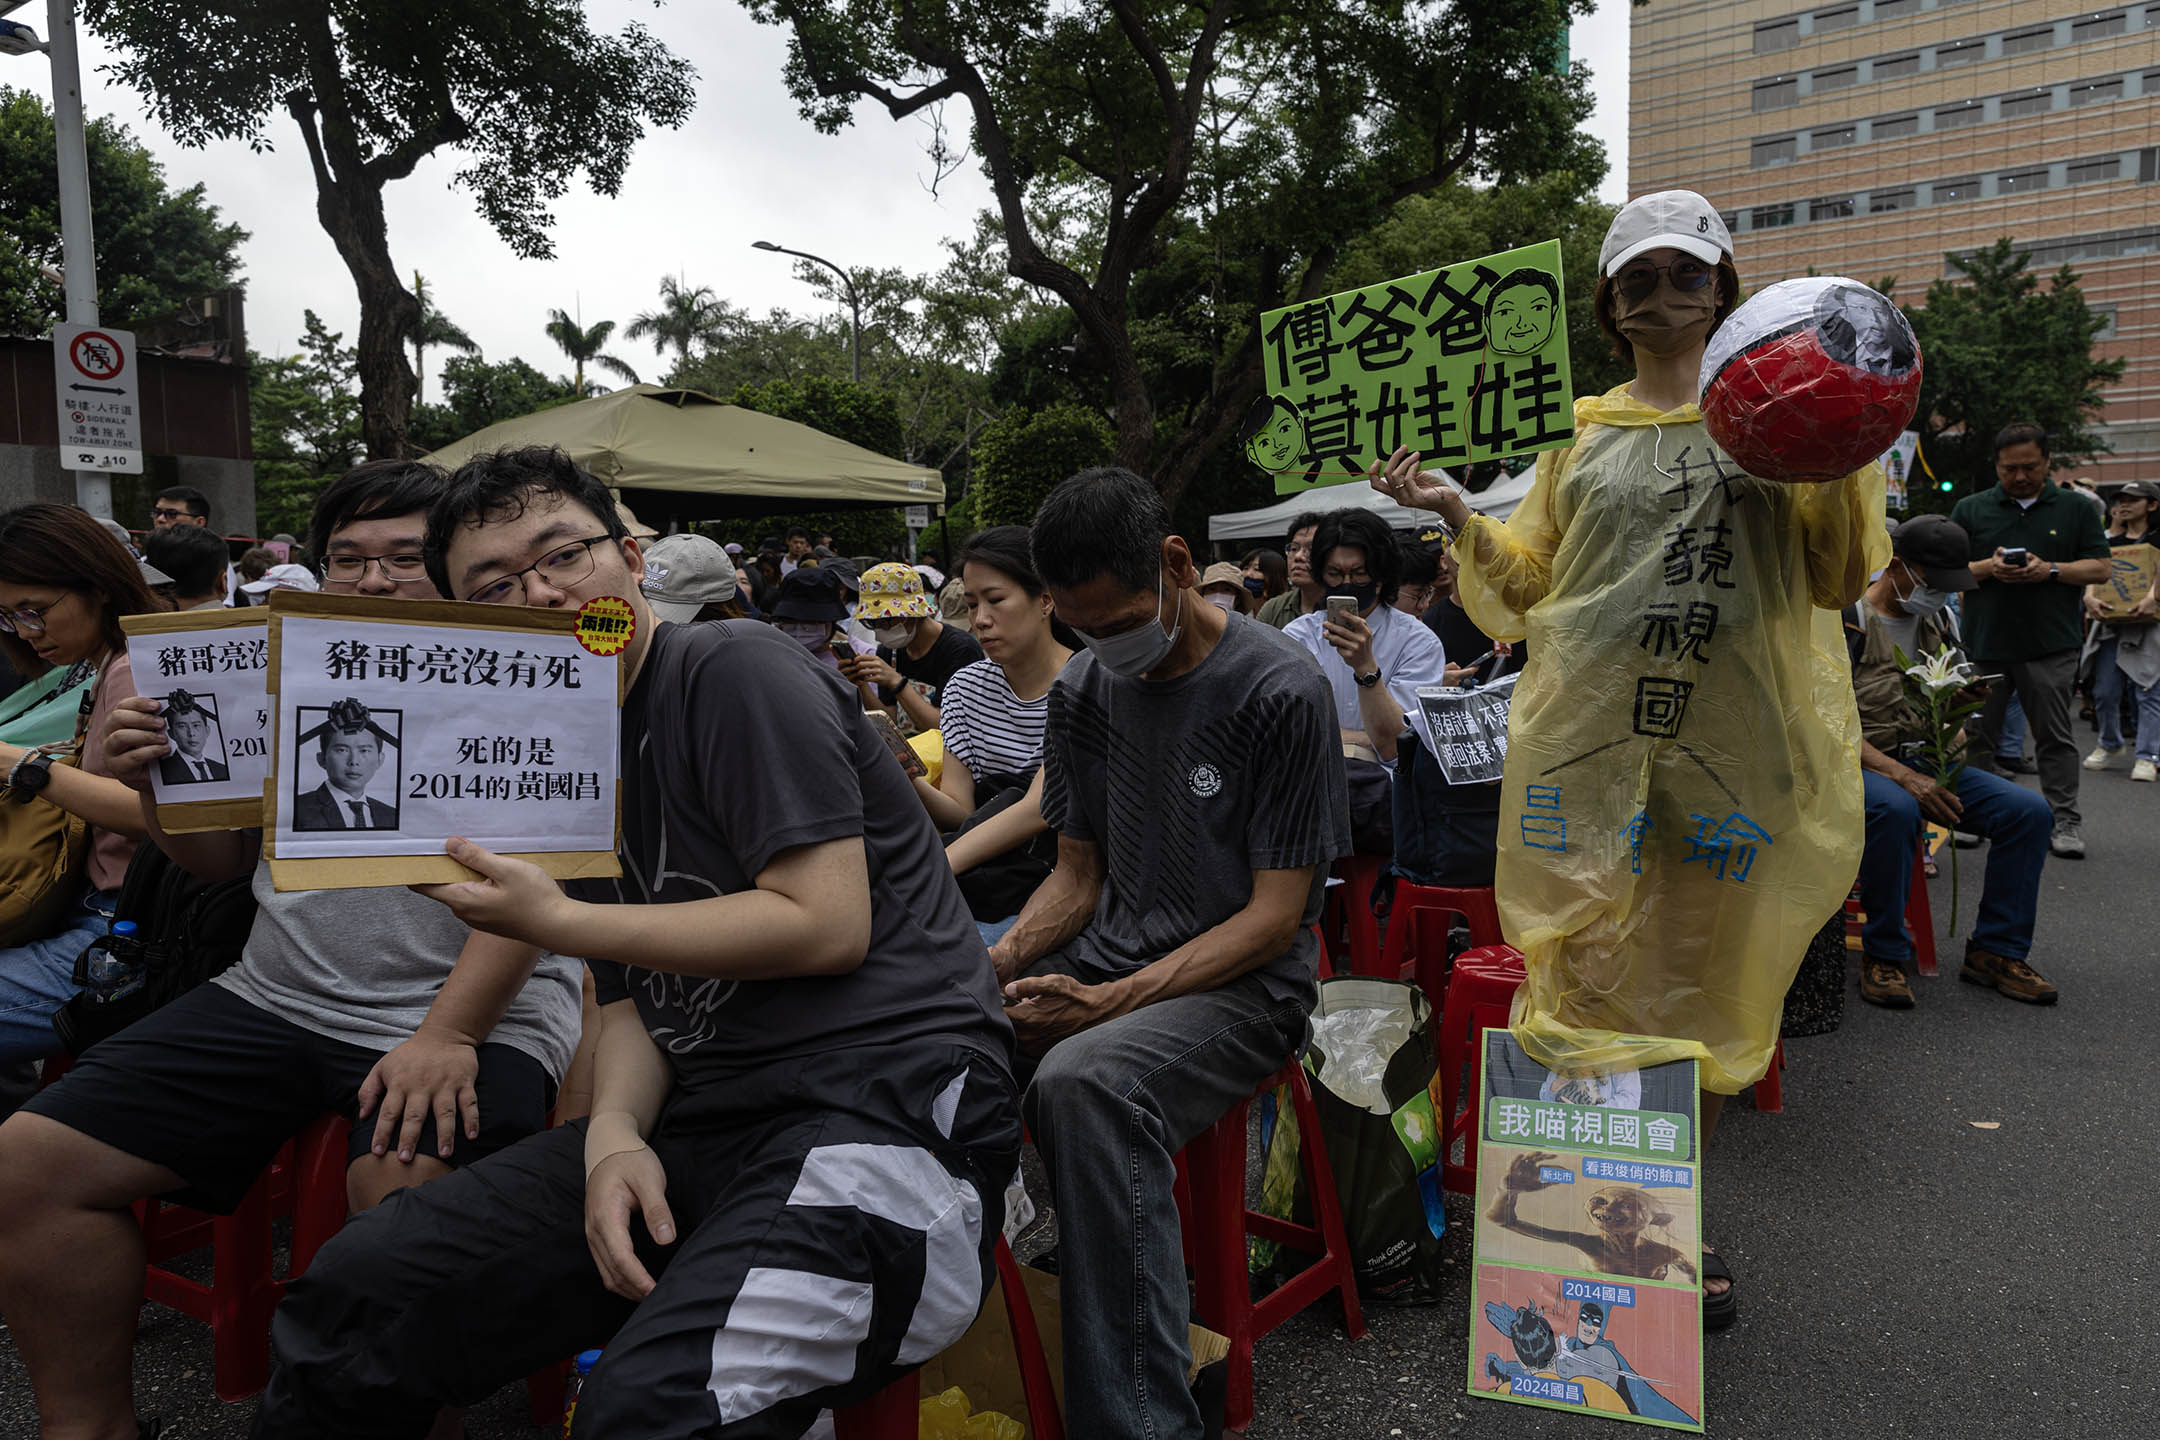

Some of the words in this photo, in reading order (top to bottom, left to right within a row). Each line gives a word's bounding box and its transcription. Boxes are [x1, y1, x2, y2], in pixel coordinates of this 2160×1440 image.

[82, 343, 111, 369] 停
[75, 424, 127, 438] 違者拖吊
[87, 415, 127, 425] SIDEWALK
[68, 436, 111, 447] TOW-AWAY
[113, 439, 134, 448] ZONE
[103, 455, 127, 466] 110
[325, 639, 582, 690] 豬哥亮沒有死
[456, 736, 555, 767] 死的是
[409, 769, 602, 802] 2014的黃國昌
[1521, 784, 1567, 852] 昌
[1682, 812, 1773, 882] 瑜
[1499, 1103, 1679, 1153] 我喵視國會
[1542, 1169, 1572, 1182] 新北市
[1585, 1159, 1689, 1185] 看我俊俏的臉龐
[1565, 1282, 1631, 1304] 2014國昌
[1514, 1377, 1580, 1401] 2024國昌
